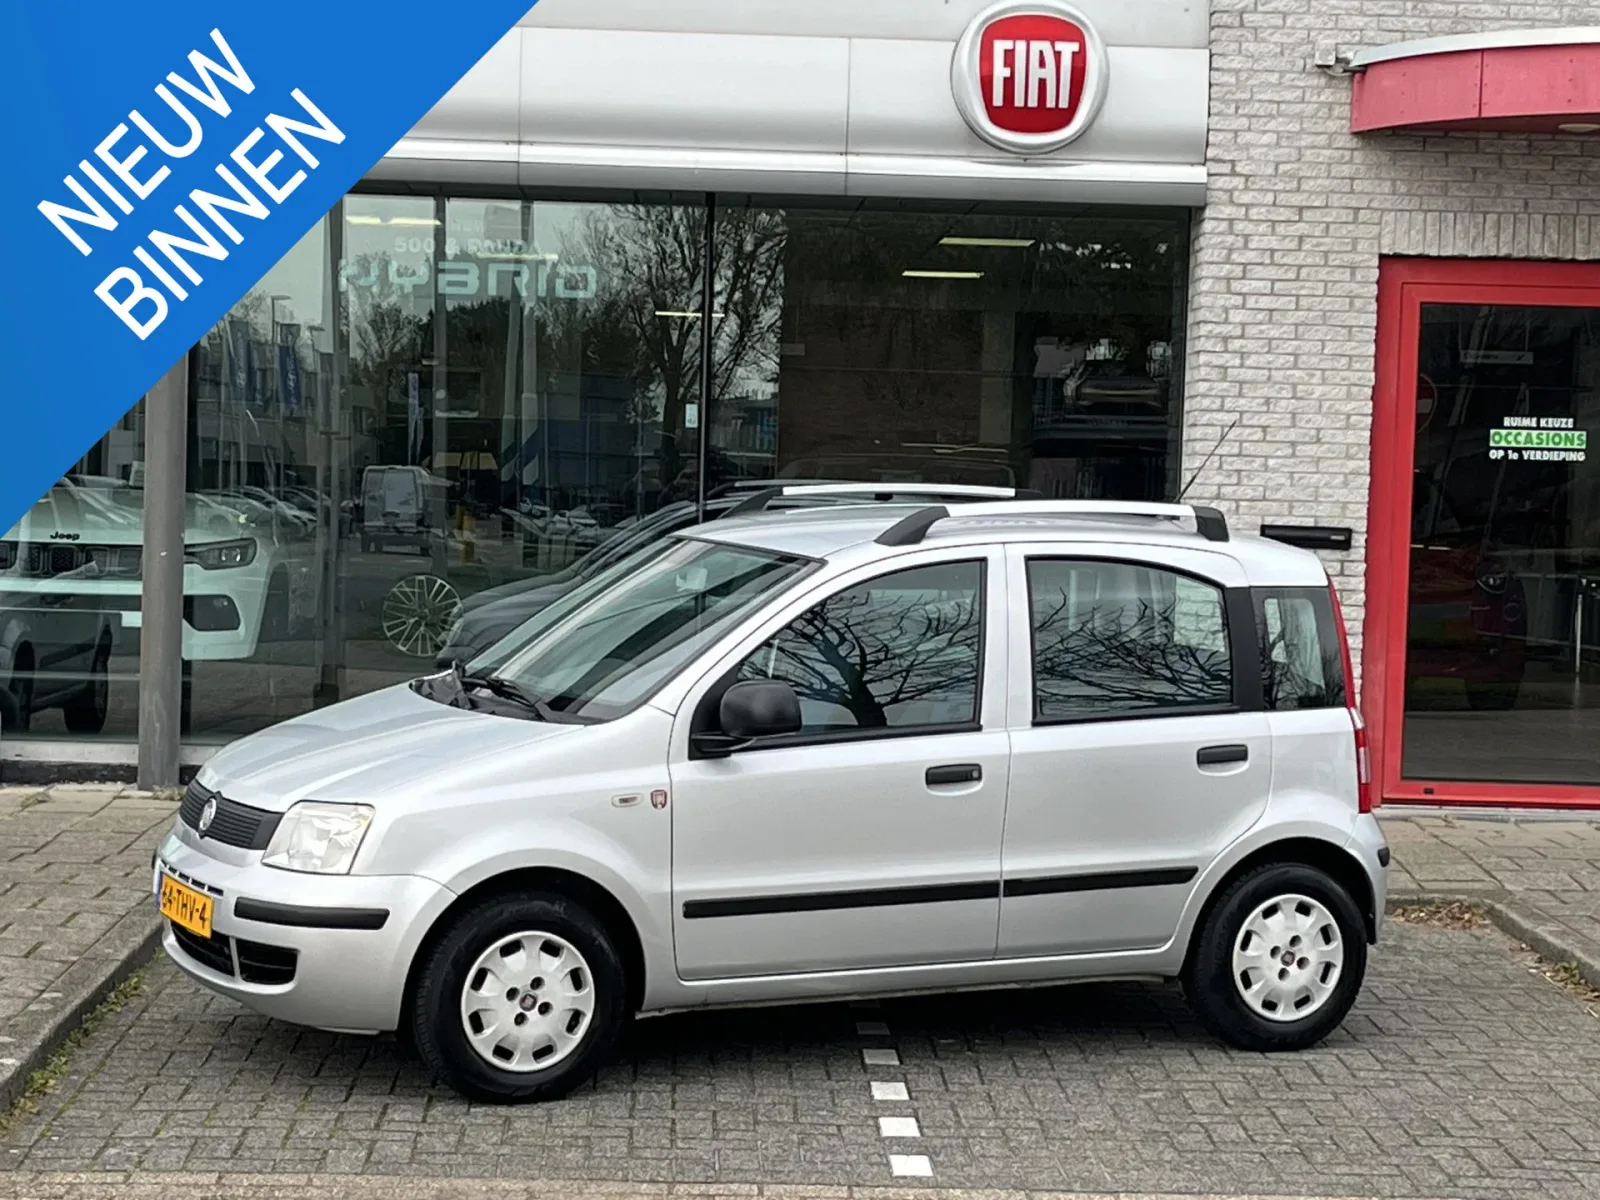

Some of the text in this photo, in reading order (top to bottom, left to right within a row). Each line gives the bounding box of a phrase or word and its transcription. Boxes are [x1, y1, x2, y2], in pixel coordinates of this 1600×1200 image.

[992, 39, 1080, 109] FIAT
[393, 236, 437, 253] 500
[1503, 416, 1574, 428] RUIME KEUZE
[1491, 431, 1586, 447] OCCASIONS
[1488, 449, 1586, 461] OP 1e VERDIEPING
[50, 531, 80, 541] Jeep
